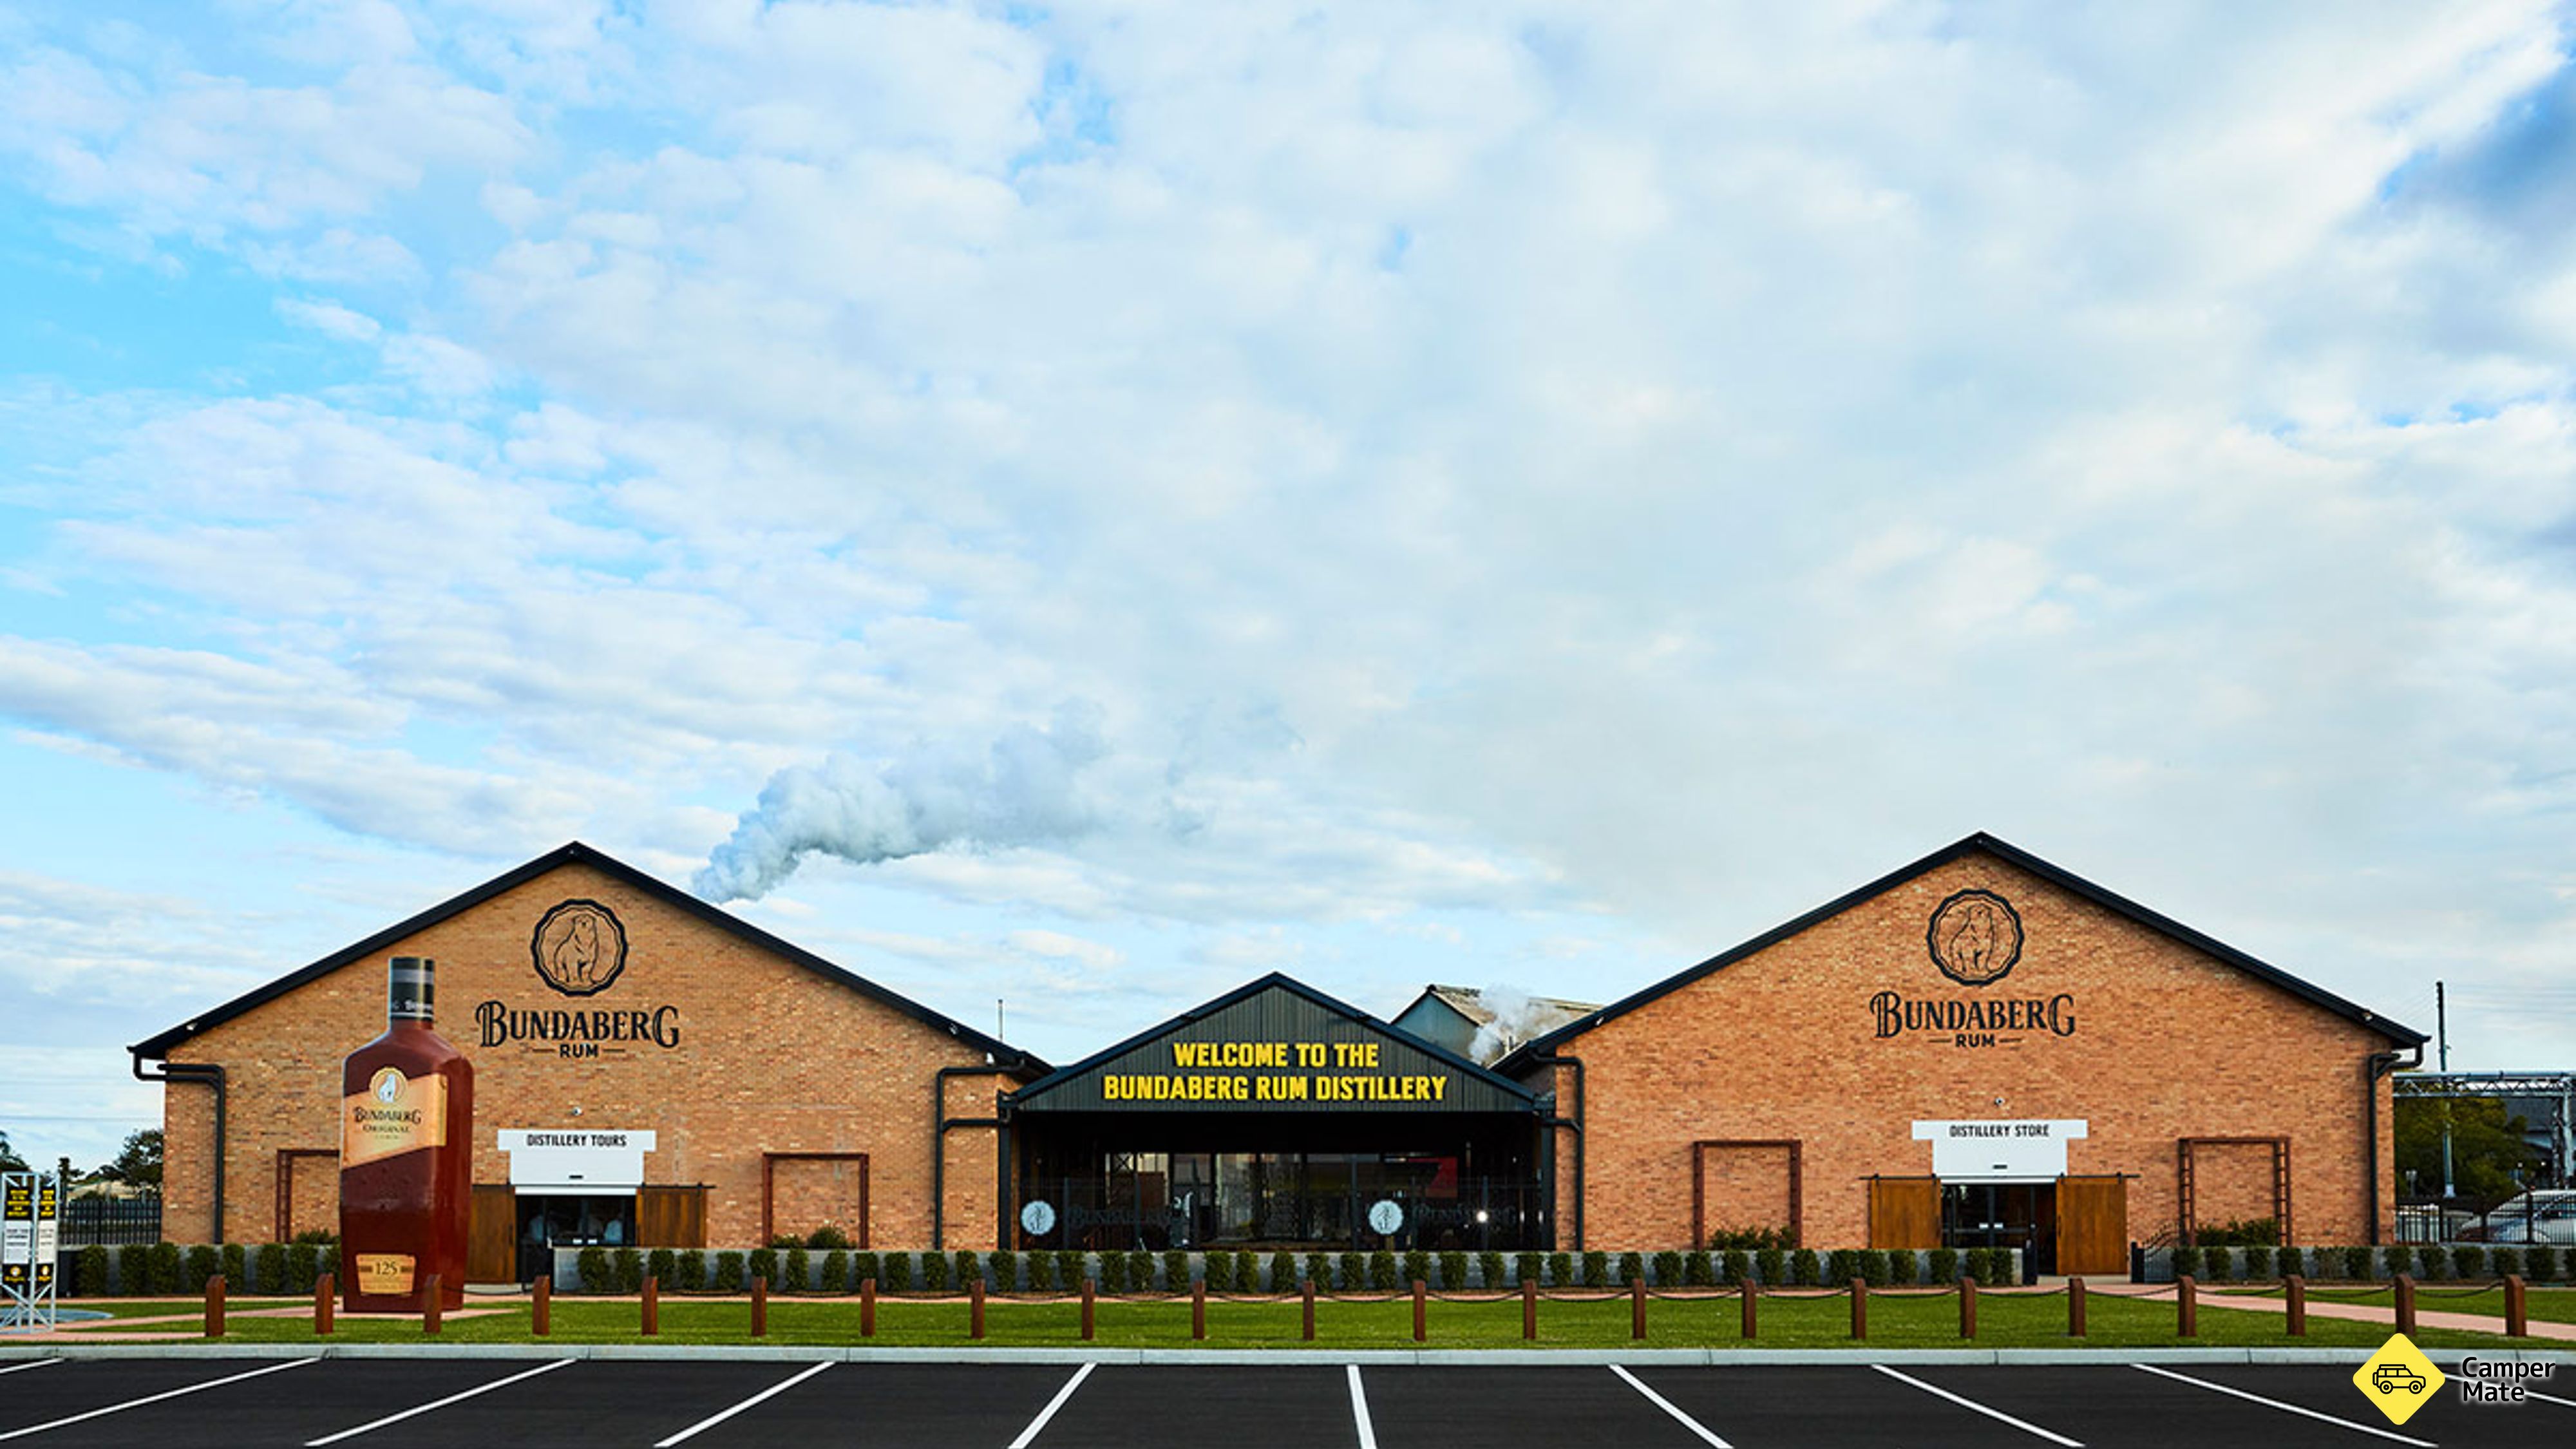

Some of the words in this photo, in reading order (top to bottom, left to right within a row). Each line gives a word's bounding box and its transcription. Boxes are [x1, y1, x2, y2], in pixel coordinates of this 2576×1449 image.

[1870, 991, 2076, 1037] BUNDABERG
[475, 1000, 679, 1048] BUNDABERG
[1955, 1034, 1995, 1048] RUM
[560, 1044, 599, 1058] RUM
[1173, 1043, 1288, 1067] WELCOME
[1296, 1043, 1326, 1067] TO
[1334, 1043, 1379, 1067] THE
[1104, 1075, 1248, 1100] BUNDABERG
[1256, 1075, 1307, 1100] RUM
[1316, 1075, 1447, 1100] DISTILLERY
[1949, 1125, 2010, 1137] DISTILLERY
[2015, 1124, 2049, 1137] STORE
[527, 1134, 586, 1146] DISTILLERY
[591, 1134, 627, 1146] TOURS
[376, 1261, 397, 1275] 125
